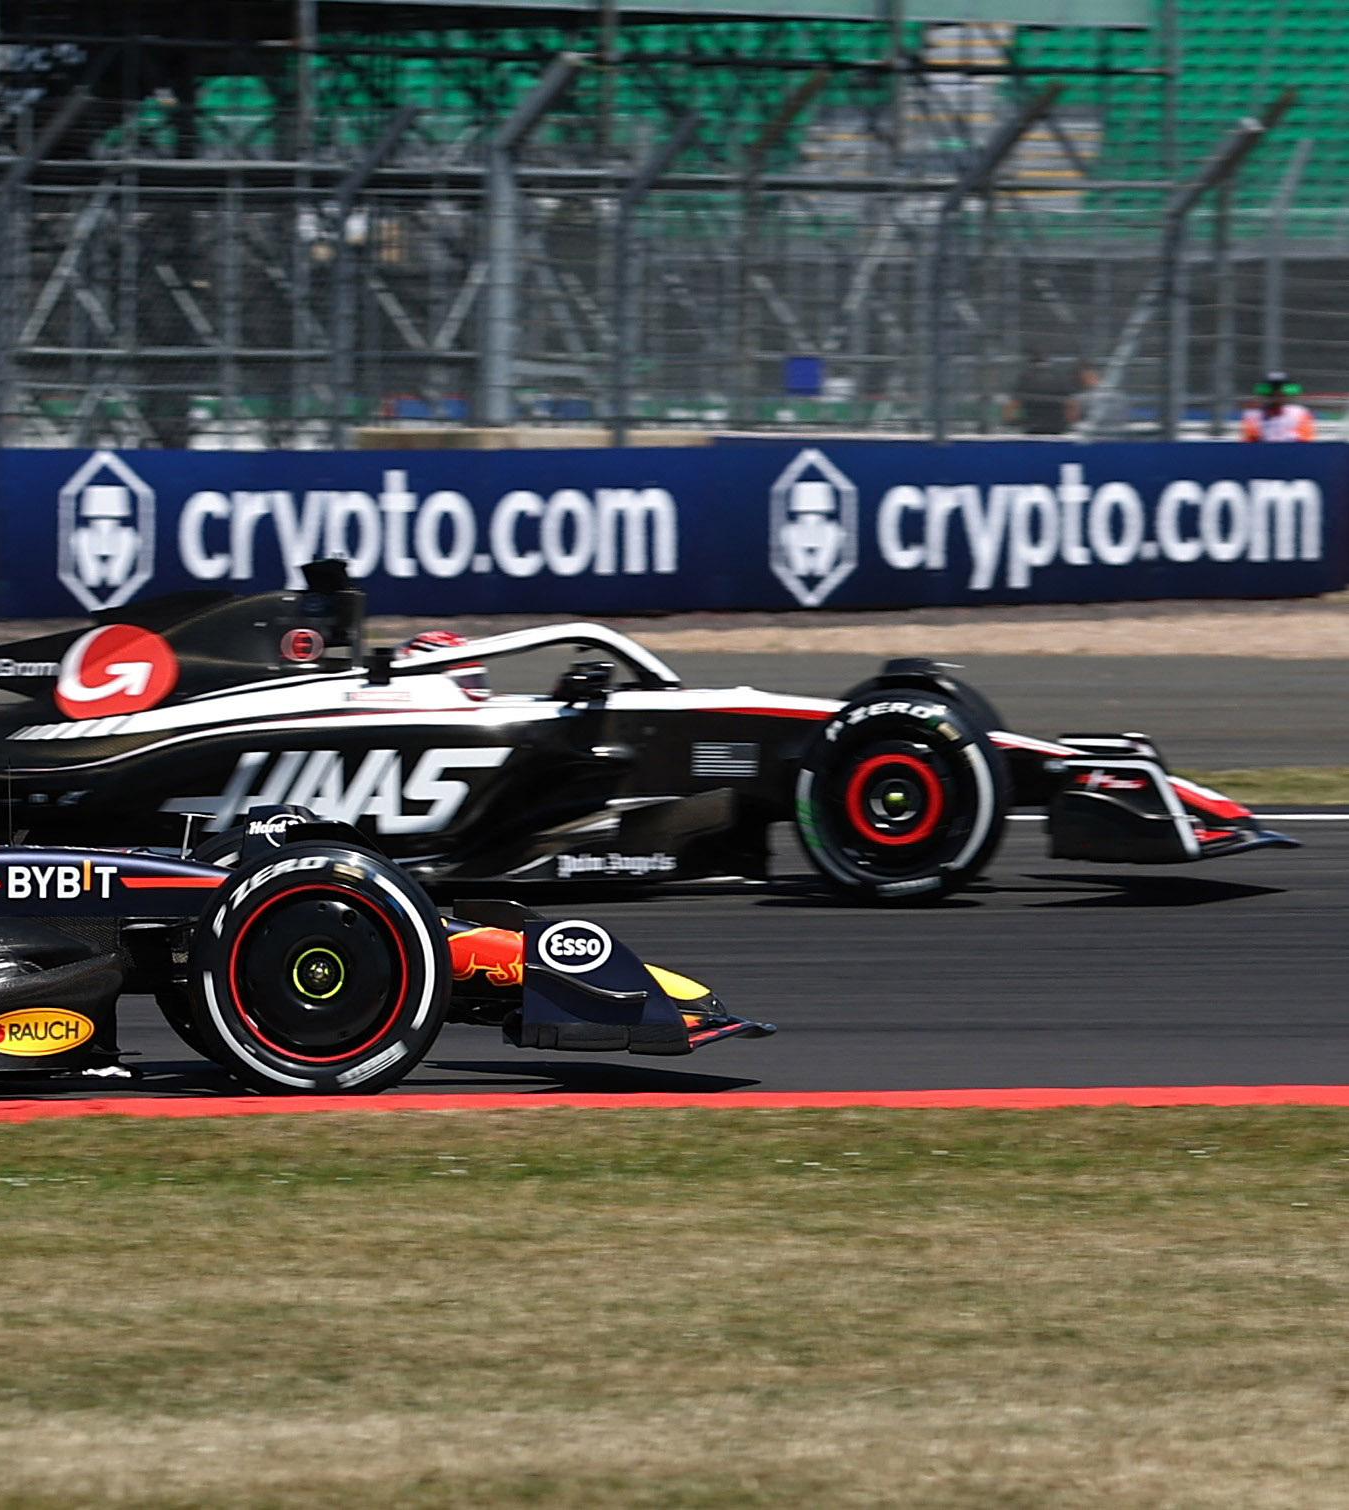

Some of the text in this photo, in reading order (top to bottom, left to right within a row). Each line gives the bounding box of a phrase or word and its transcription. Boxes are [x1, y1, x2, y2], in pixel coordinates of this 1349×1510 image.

[178, 469, 678, 591] crypto.com
[877, 462, 1323, 590] crypto.com
[158, 747, 514, 834] HAAS
[249, 820, 287, 835] Hard
[8, 859, 118, 899] BYBIT
[229, 856, 331, 911] ZERO
[550, 933, 601, 956] Esso
[9, 1021, 79, 1042] RAUCH
